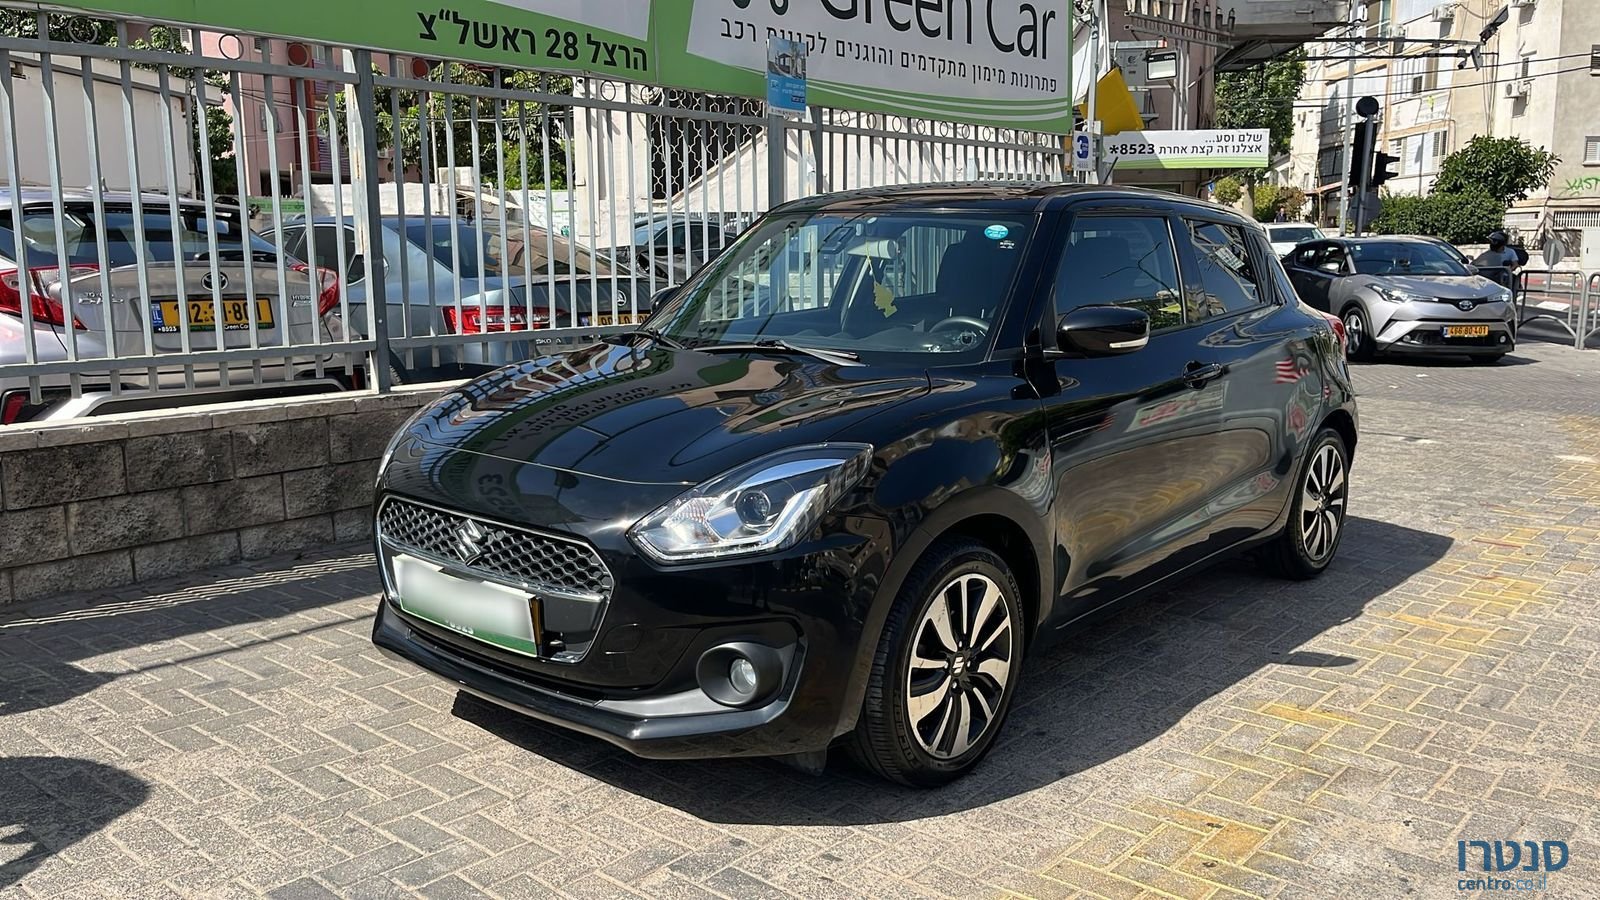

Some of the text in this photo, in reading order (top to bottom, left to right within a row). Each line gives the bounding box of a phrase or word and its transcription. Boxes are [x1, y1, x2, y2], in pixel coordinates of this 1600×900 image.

[721, 17, 757, 42] רכב
[986, 0, 1056, 60] Car
[544, 28, 579, 61] 28
[586, 33, 648, 72] הרצל
[836, 39, 894, 66] והוגנים
[901, 51, 967, 79] מתקדמים
[972, 64, 1006, 84] מימון
[1010, 70, 1057, 93] פתרונות
[1158, 144, 1188, 154] אחרת
[1217, 144, 1229, 153] זה
[1232, 144, 1262, 154] אצלנו
[1239, 133, 1263, 143] שלם
[1190, 144, 1213, 156] קצת
